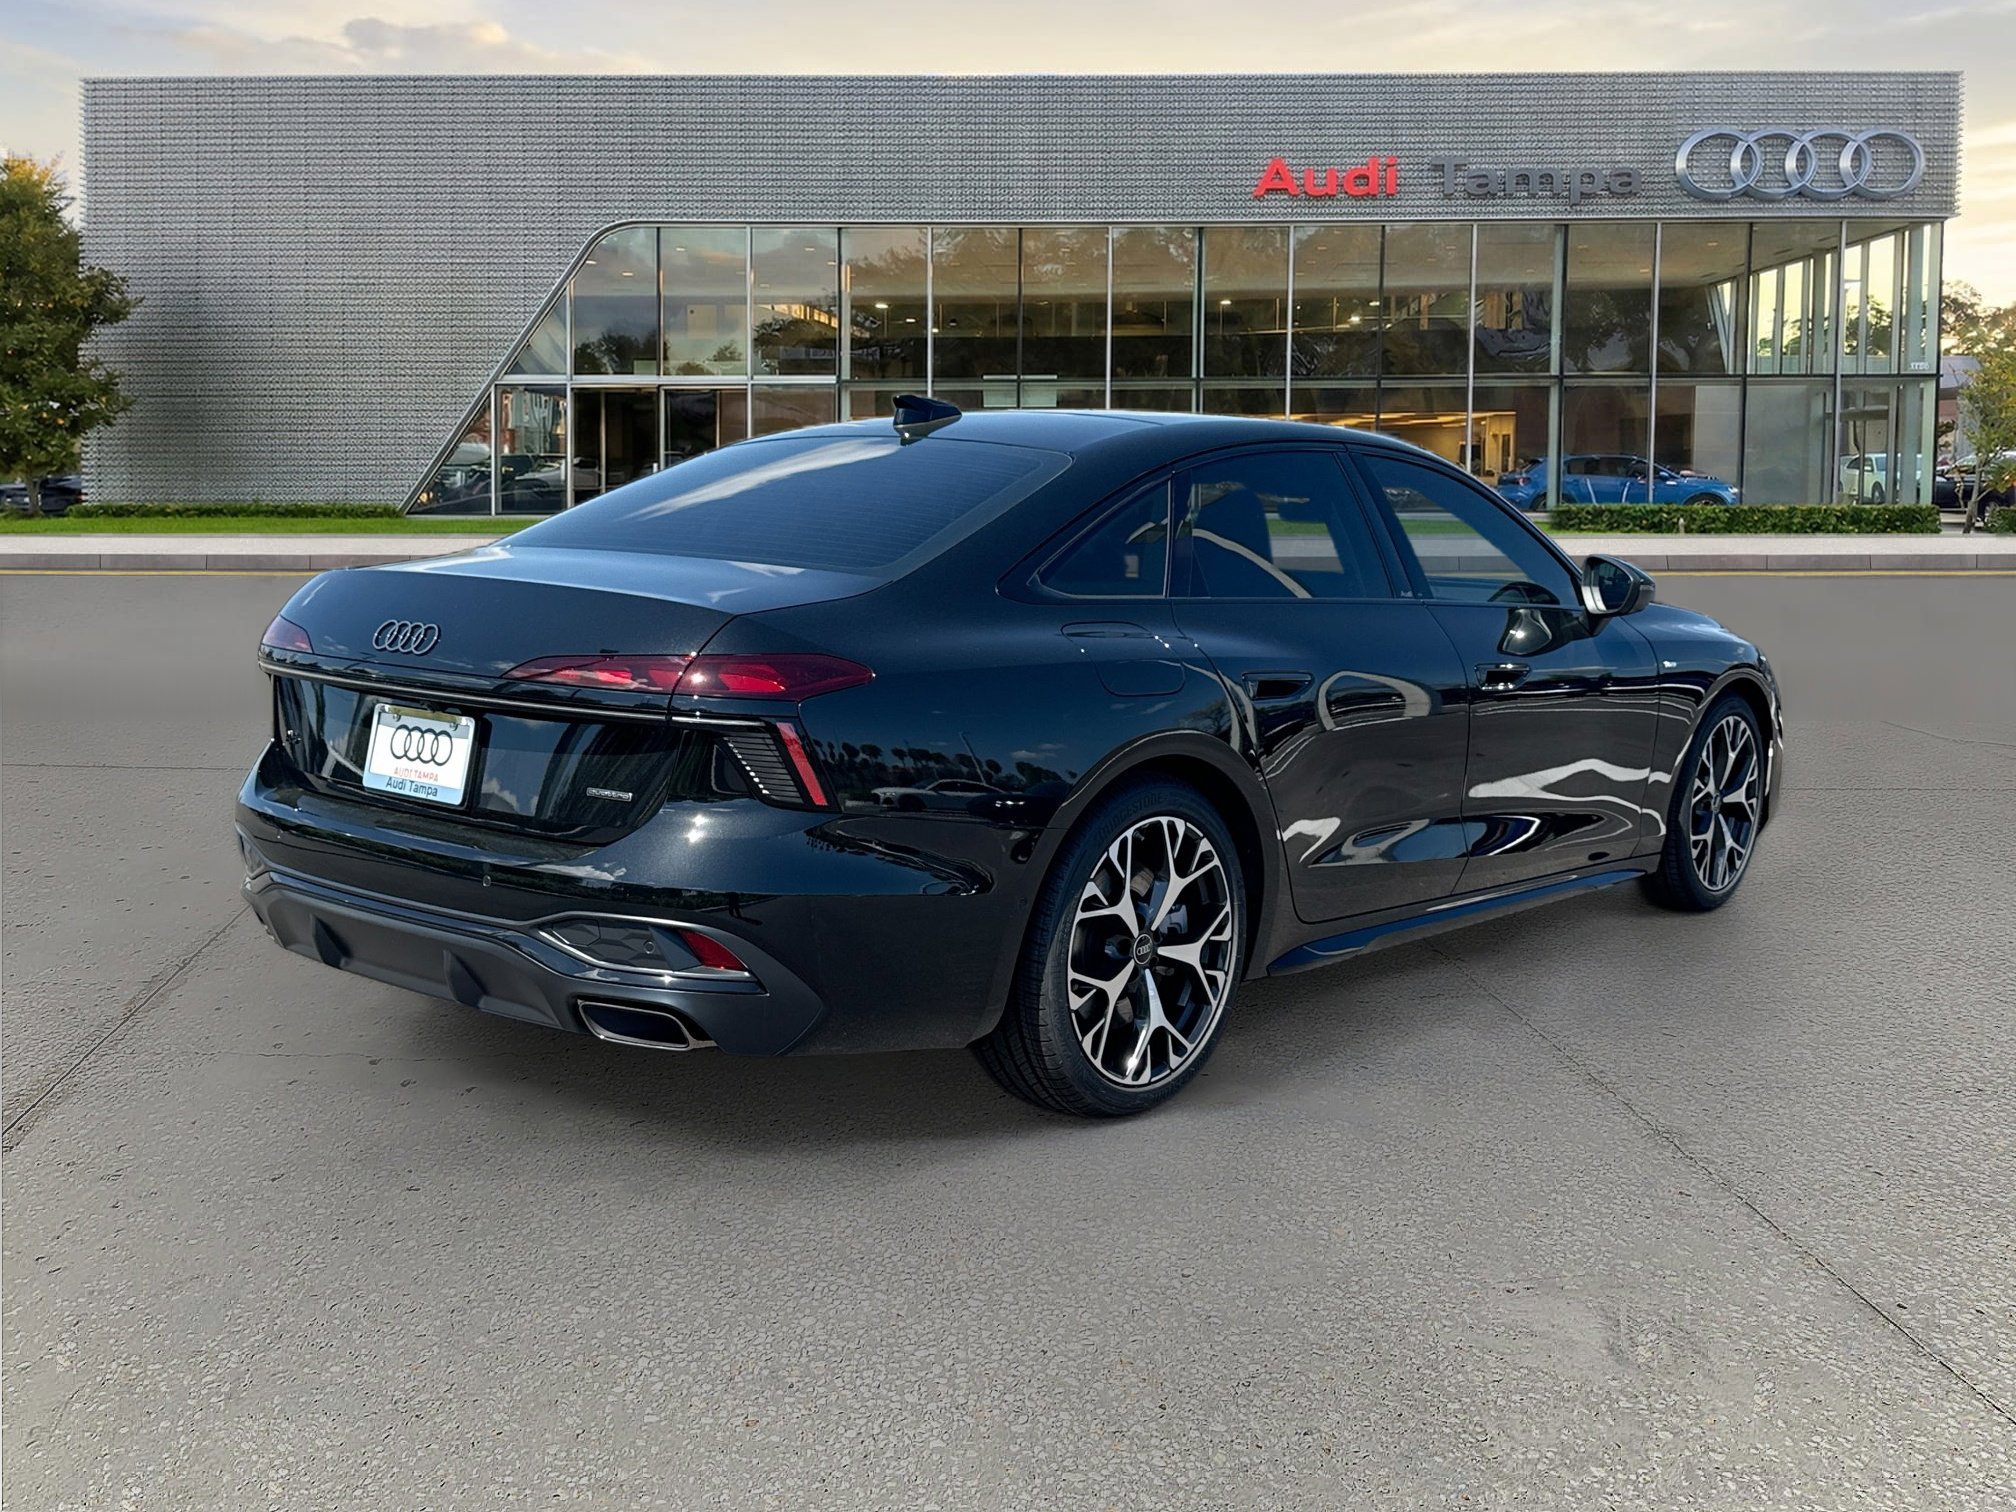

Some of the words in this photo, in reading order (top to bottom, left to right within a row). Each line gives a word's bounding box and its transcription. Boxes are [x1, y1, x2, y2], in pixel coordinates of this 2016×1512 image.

[1253, 155, 1398, 197] Audi
[1430, 155, 1642, 206] Tampa
[394, 767, 412, 778] AUDI
[414, 770, 438, 782] TAMPA
[386, 777, 406, 789] Audi
[409, 781, 438, 797] Tampa
